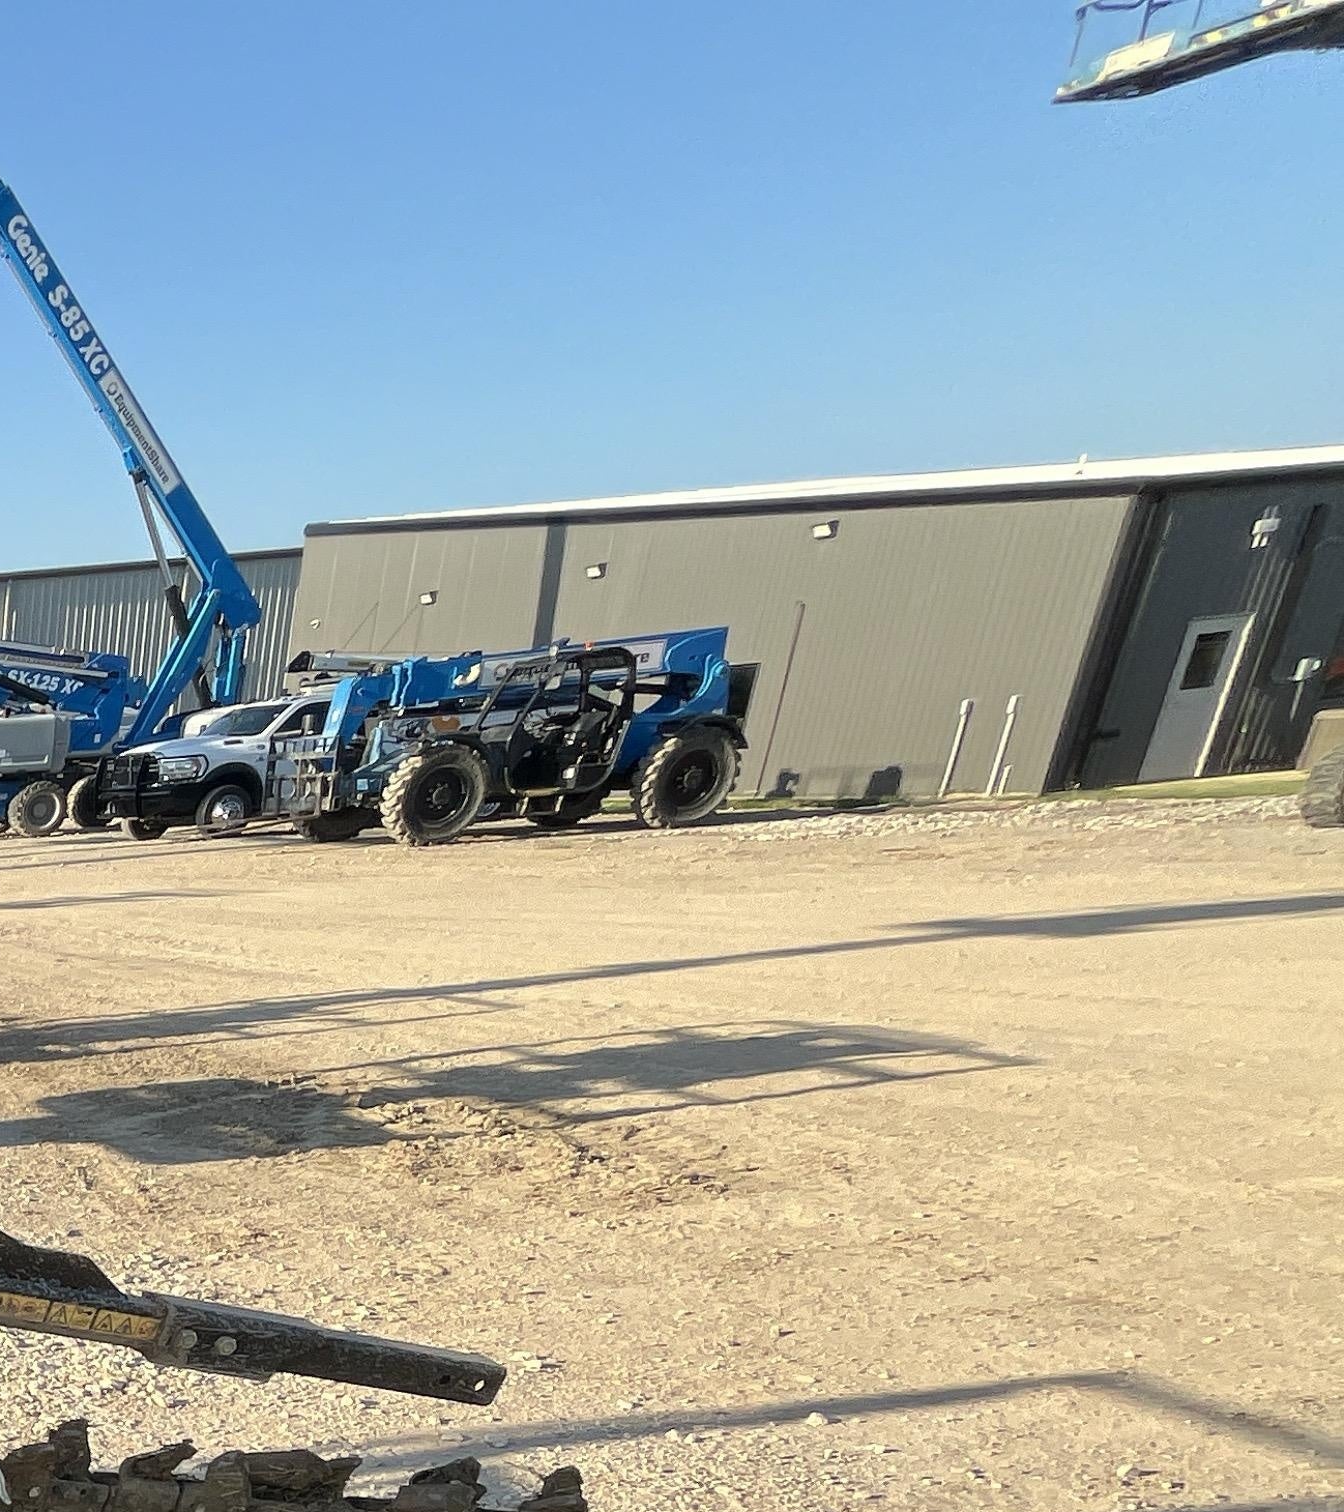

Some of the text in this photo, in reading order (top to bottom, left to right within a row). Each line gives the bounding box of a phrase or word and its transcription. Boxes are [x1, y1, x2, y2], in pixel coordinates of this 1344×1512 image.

[7, 214, 110, 375] Genie S-85 XC
[114, 394, 171, 484] EquipmentShare
